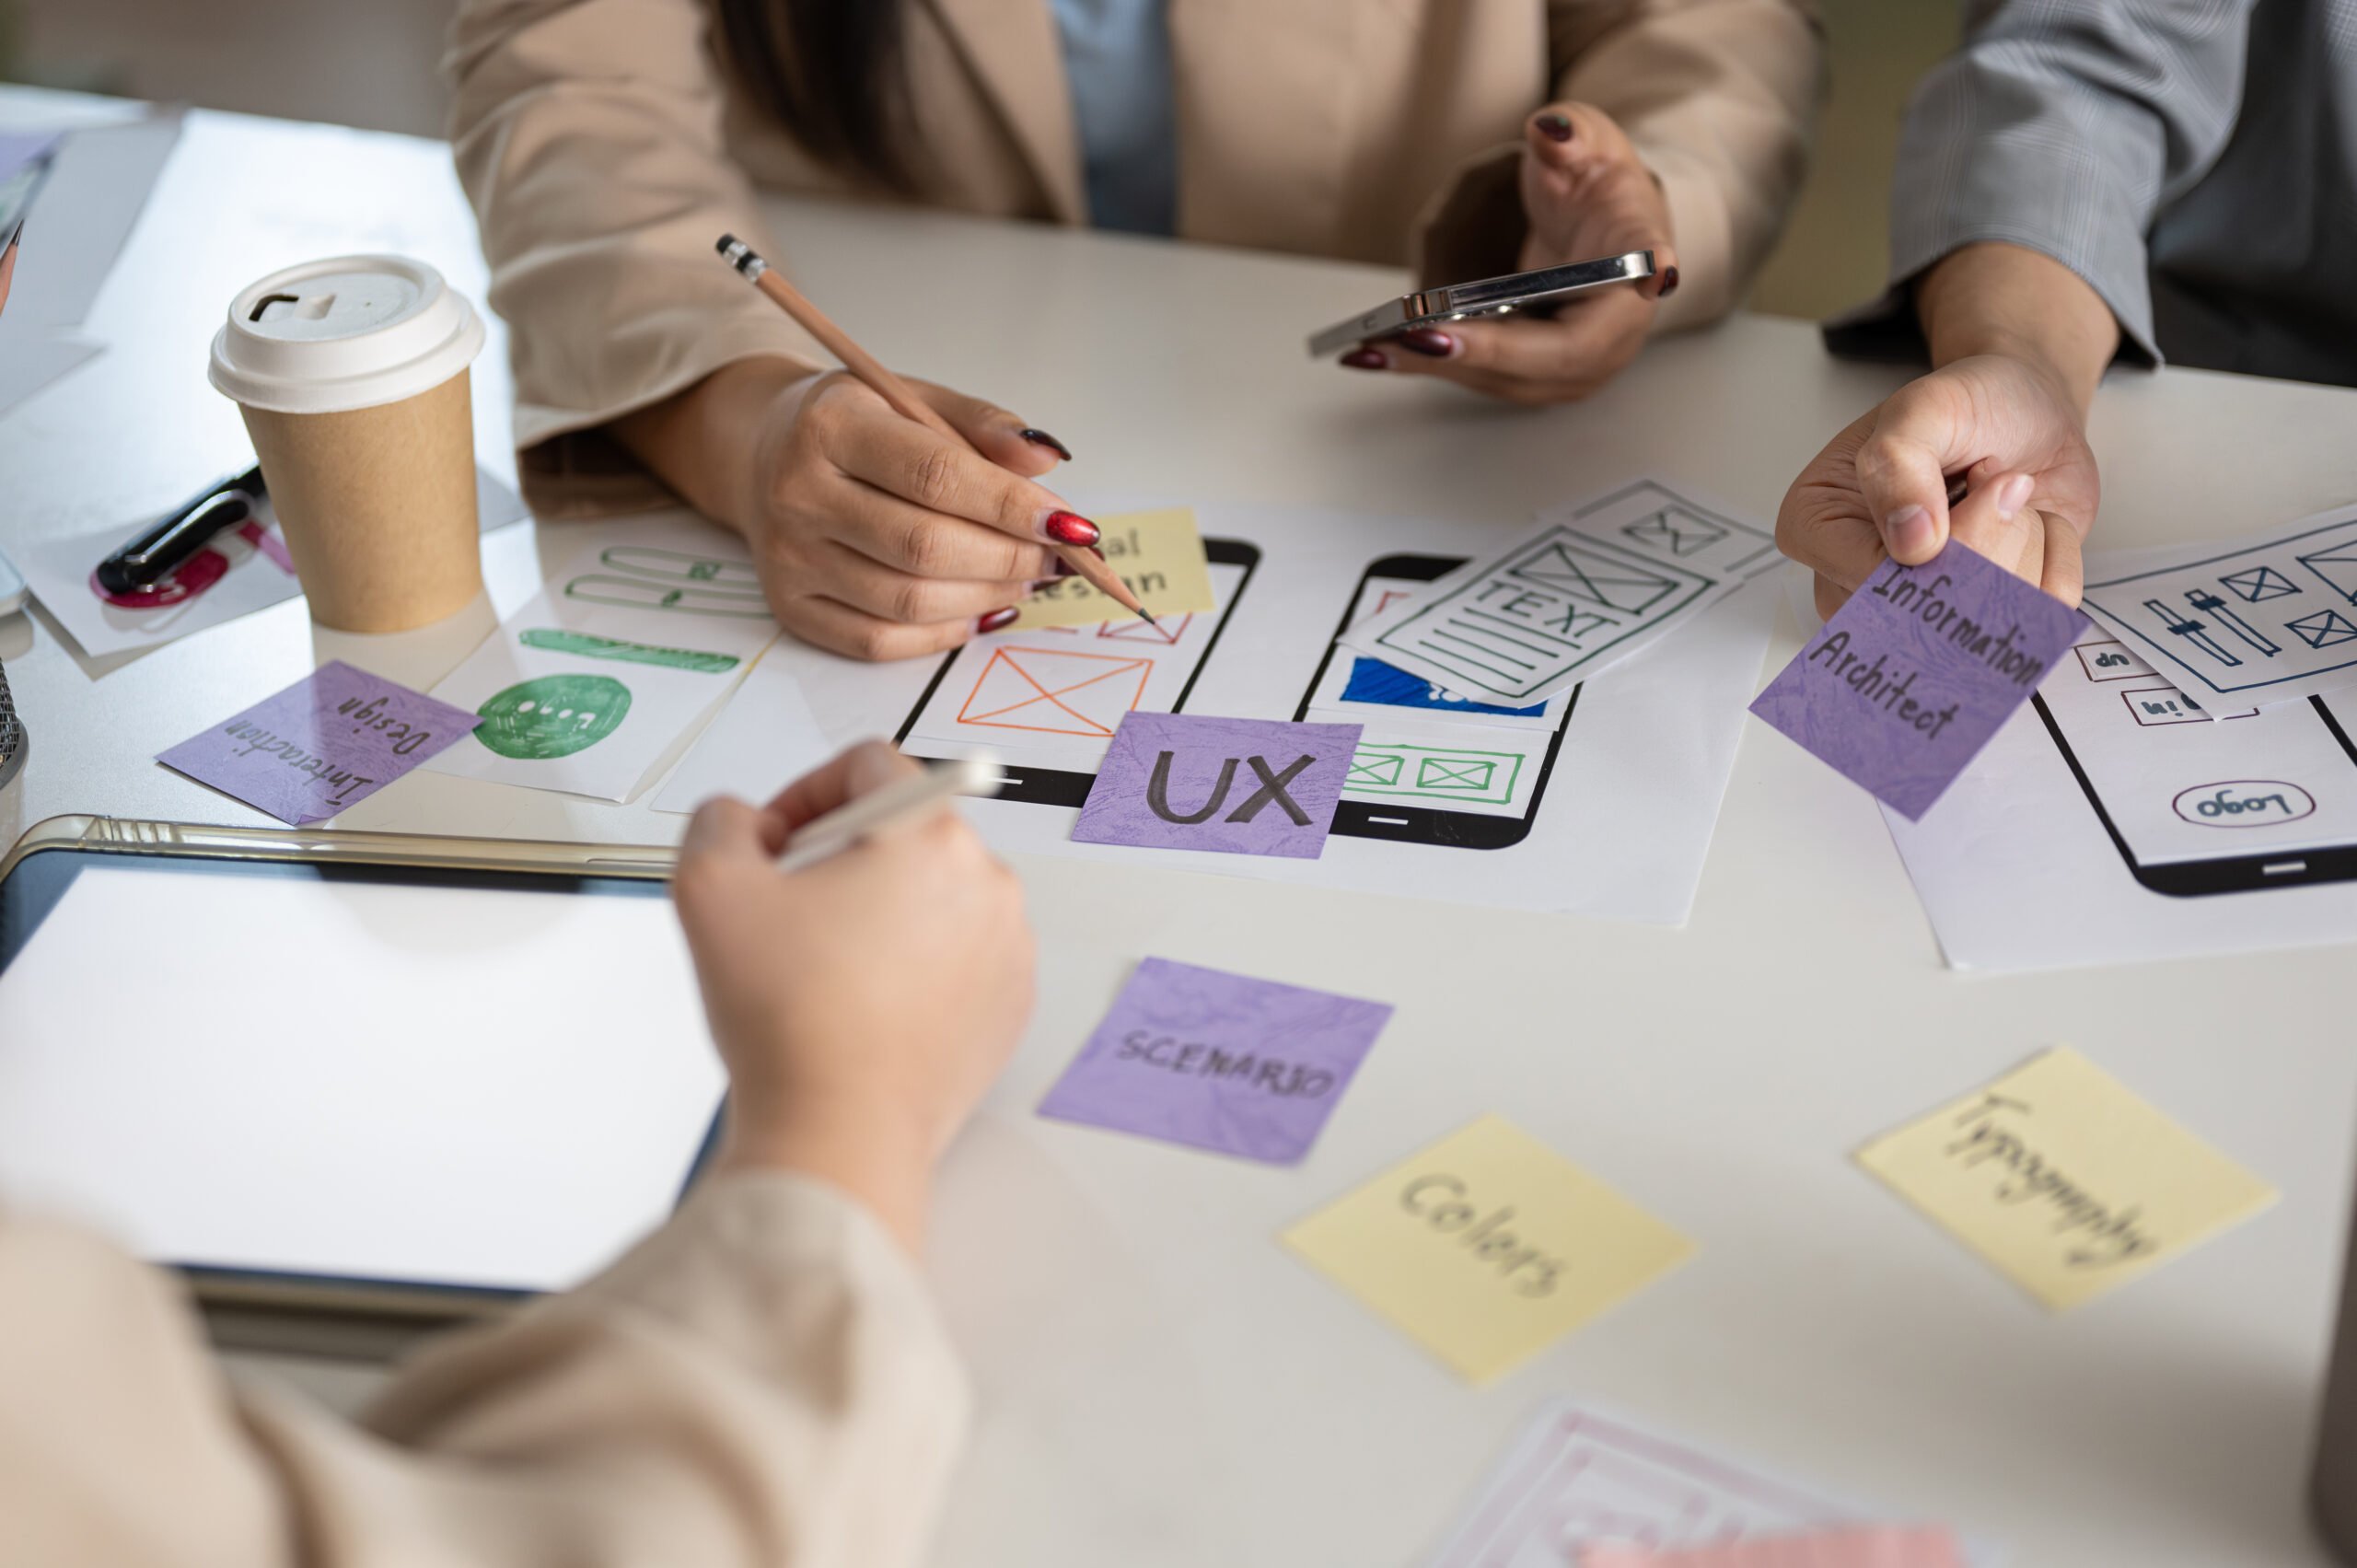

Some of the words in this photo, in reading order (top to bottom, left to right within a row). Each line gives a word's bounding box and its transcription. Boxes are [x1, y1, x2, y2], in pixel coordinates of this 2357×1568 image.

[1476, 582, 1621, 638] TEXT
[1872, 565, 2043, 685] Information
[1809, 632, 1960, 738] Architect
[225, 720, 373, 807] Interaction
[337, 698, 431, 756] Design
[1146, 750, 1318, 826] UX
[2197, 790, 2292, 817] Logo
[1116, 1030, 1334, 1098] SCENARIO
[1945, 1093, 2159, 1270] Typography
[1399, 1174, 1569, 1299] Colors
